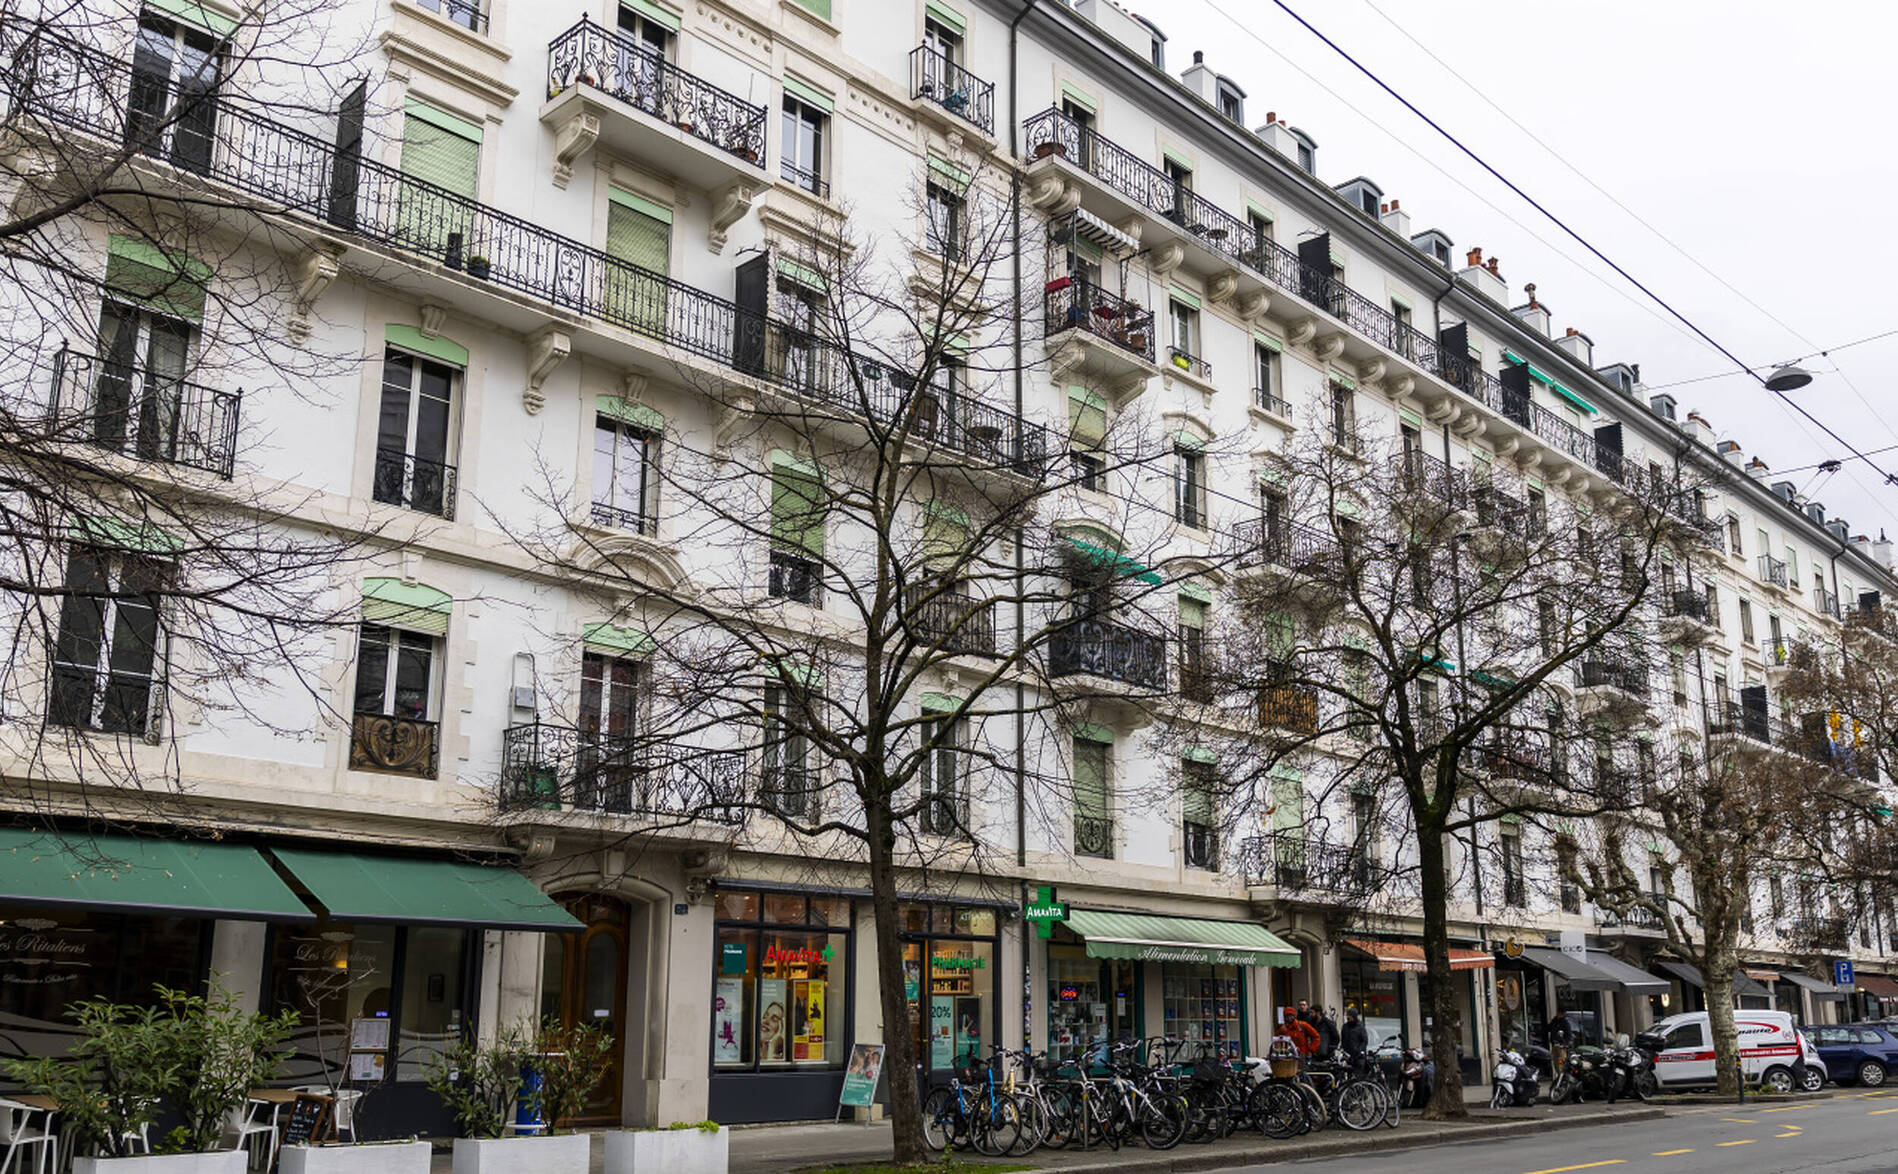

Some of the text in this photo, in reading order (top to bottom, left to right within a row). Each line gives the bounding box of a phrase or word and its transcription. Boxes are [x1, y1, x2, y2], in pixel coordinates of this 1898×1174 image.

[1026, 906, 1063, 920] AMAVITA
[16, 934, 85, 953] Ritaliens
[765, 945, 822, 964] AMAVITA
[932, 956, 986, 969] PHARMACIE
[1138, 947, 1208, 963] Alimentation
